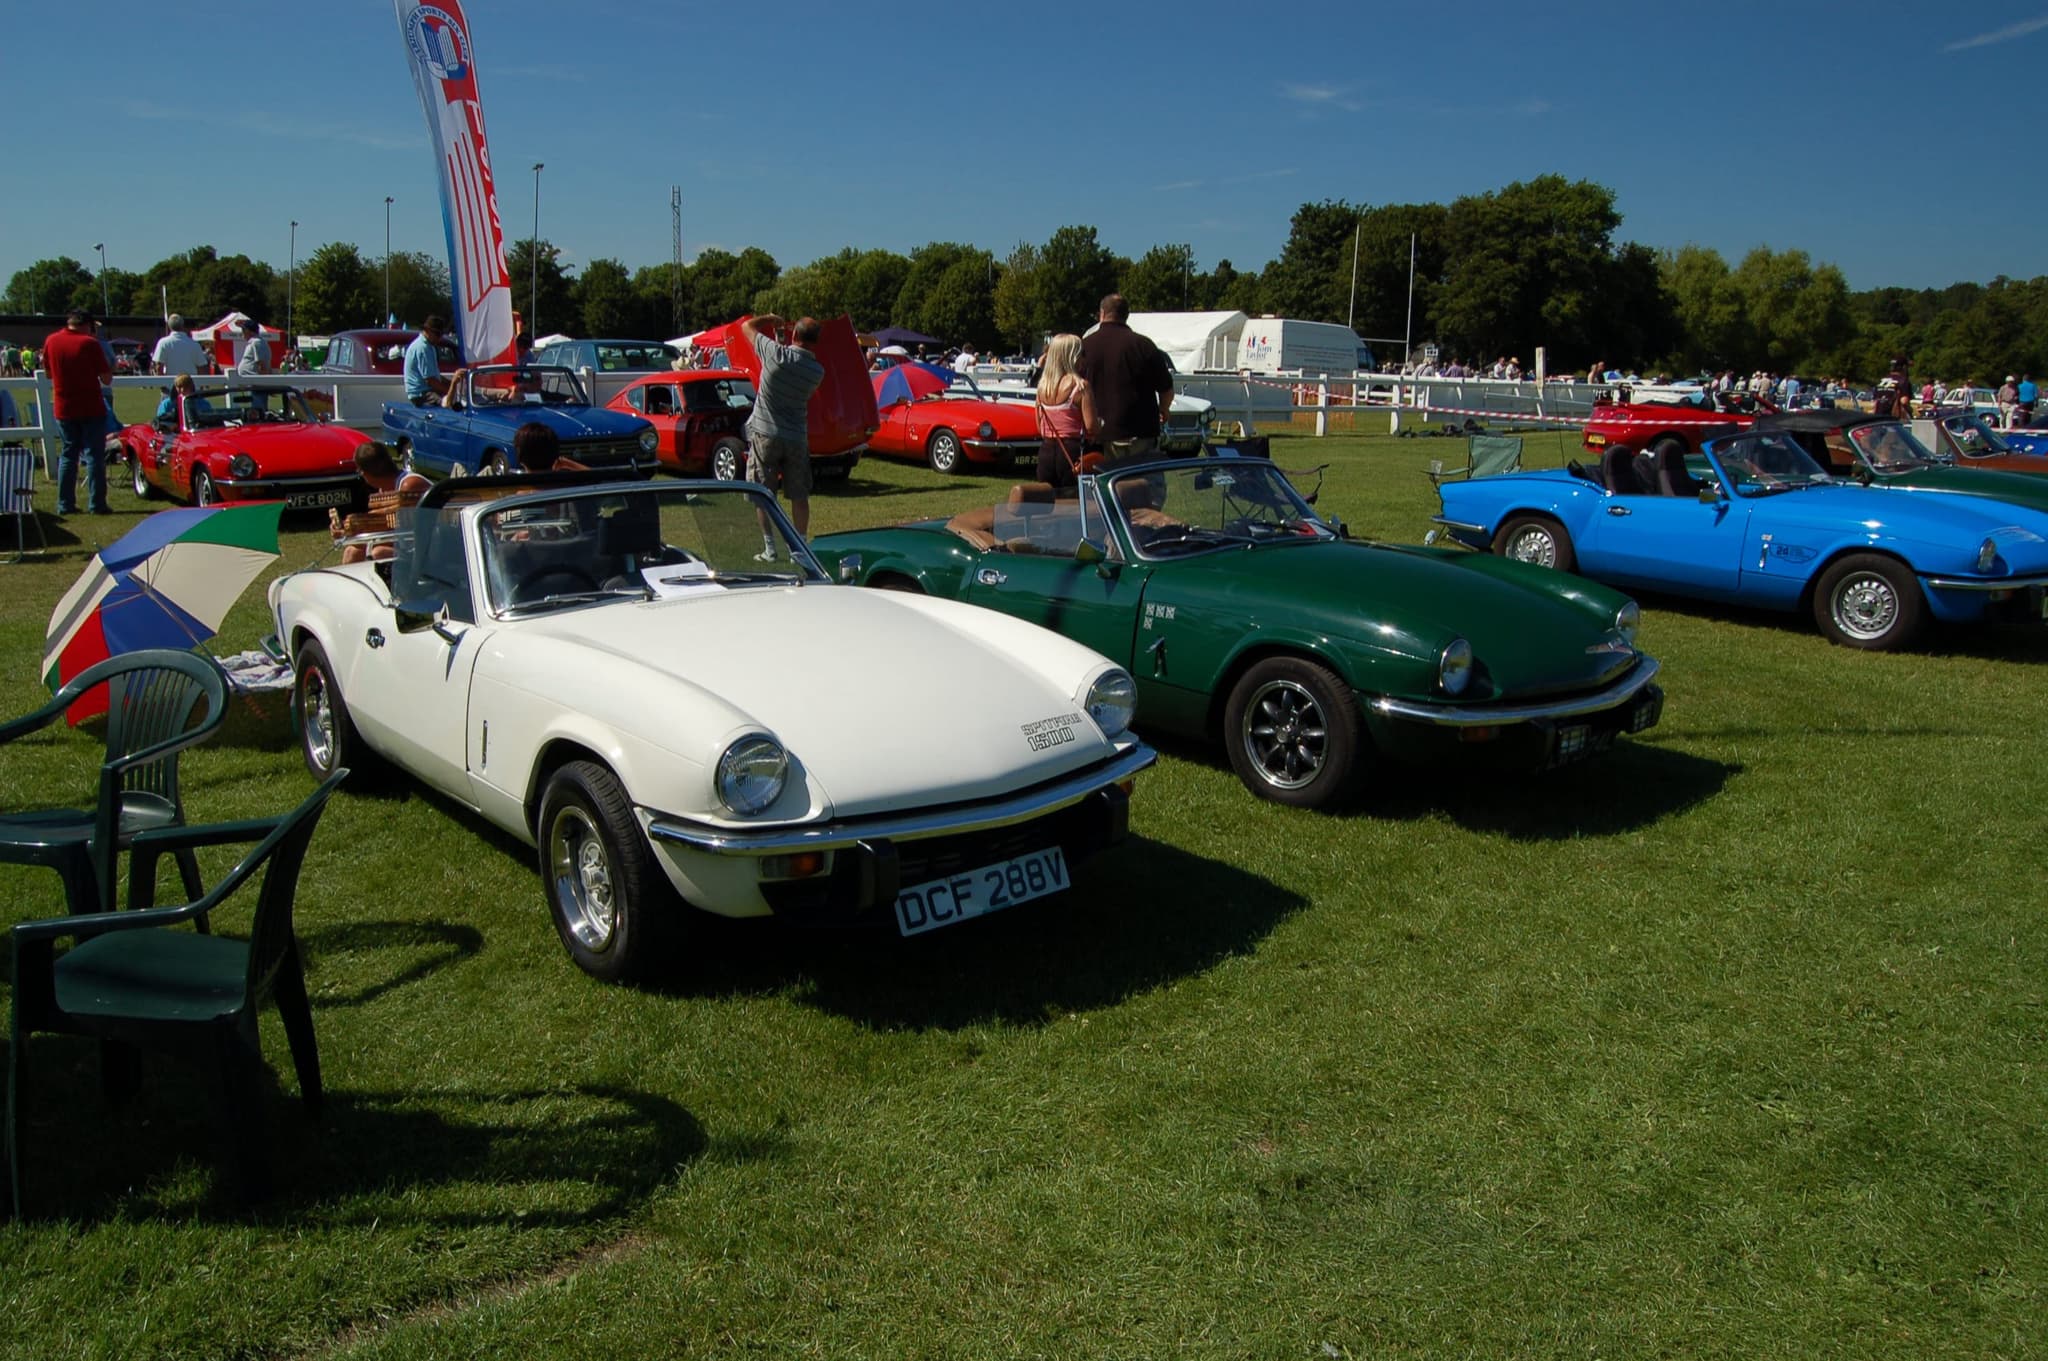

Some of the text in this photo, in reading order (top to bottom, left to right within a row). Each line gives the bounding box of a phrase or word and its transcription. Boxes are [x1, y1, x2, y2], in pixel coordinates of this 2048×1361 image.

[417, 7, 447, 20] SPORTS
[1021, 713, 1082, 736] SPITFIRE
[1027, 727, 1075, 752] 1500
[898, 851, 1063, 931] DCF 288V
